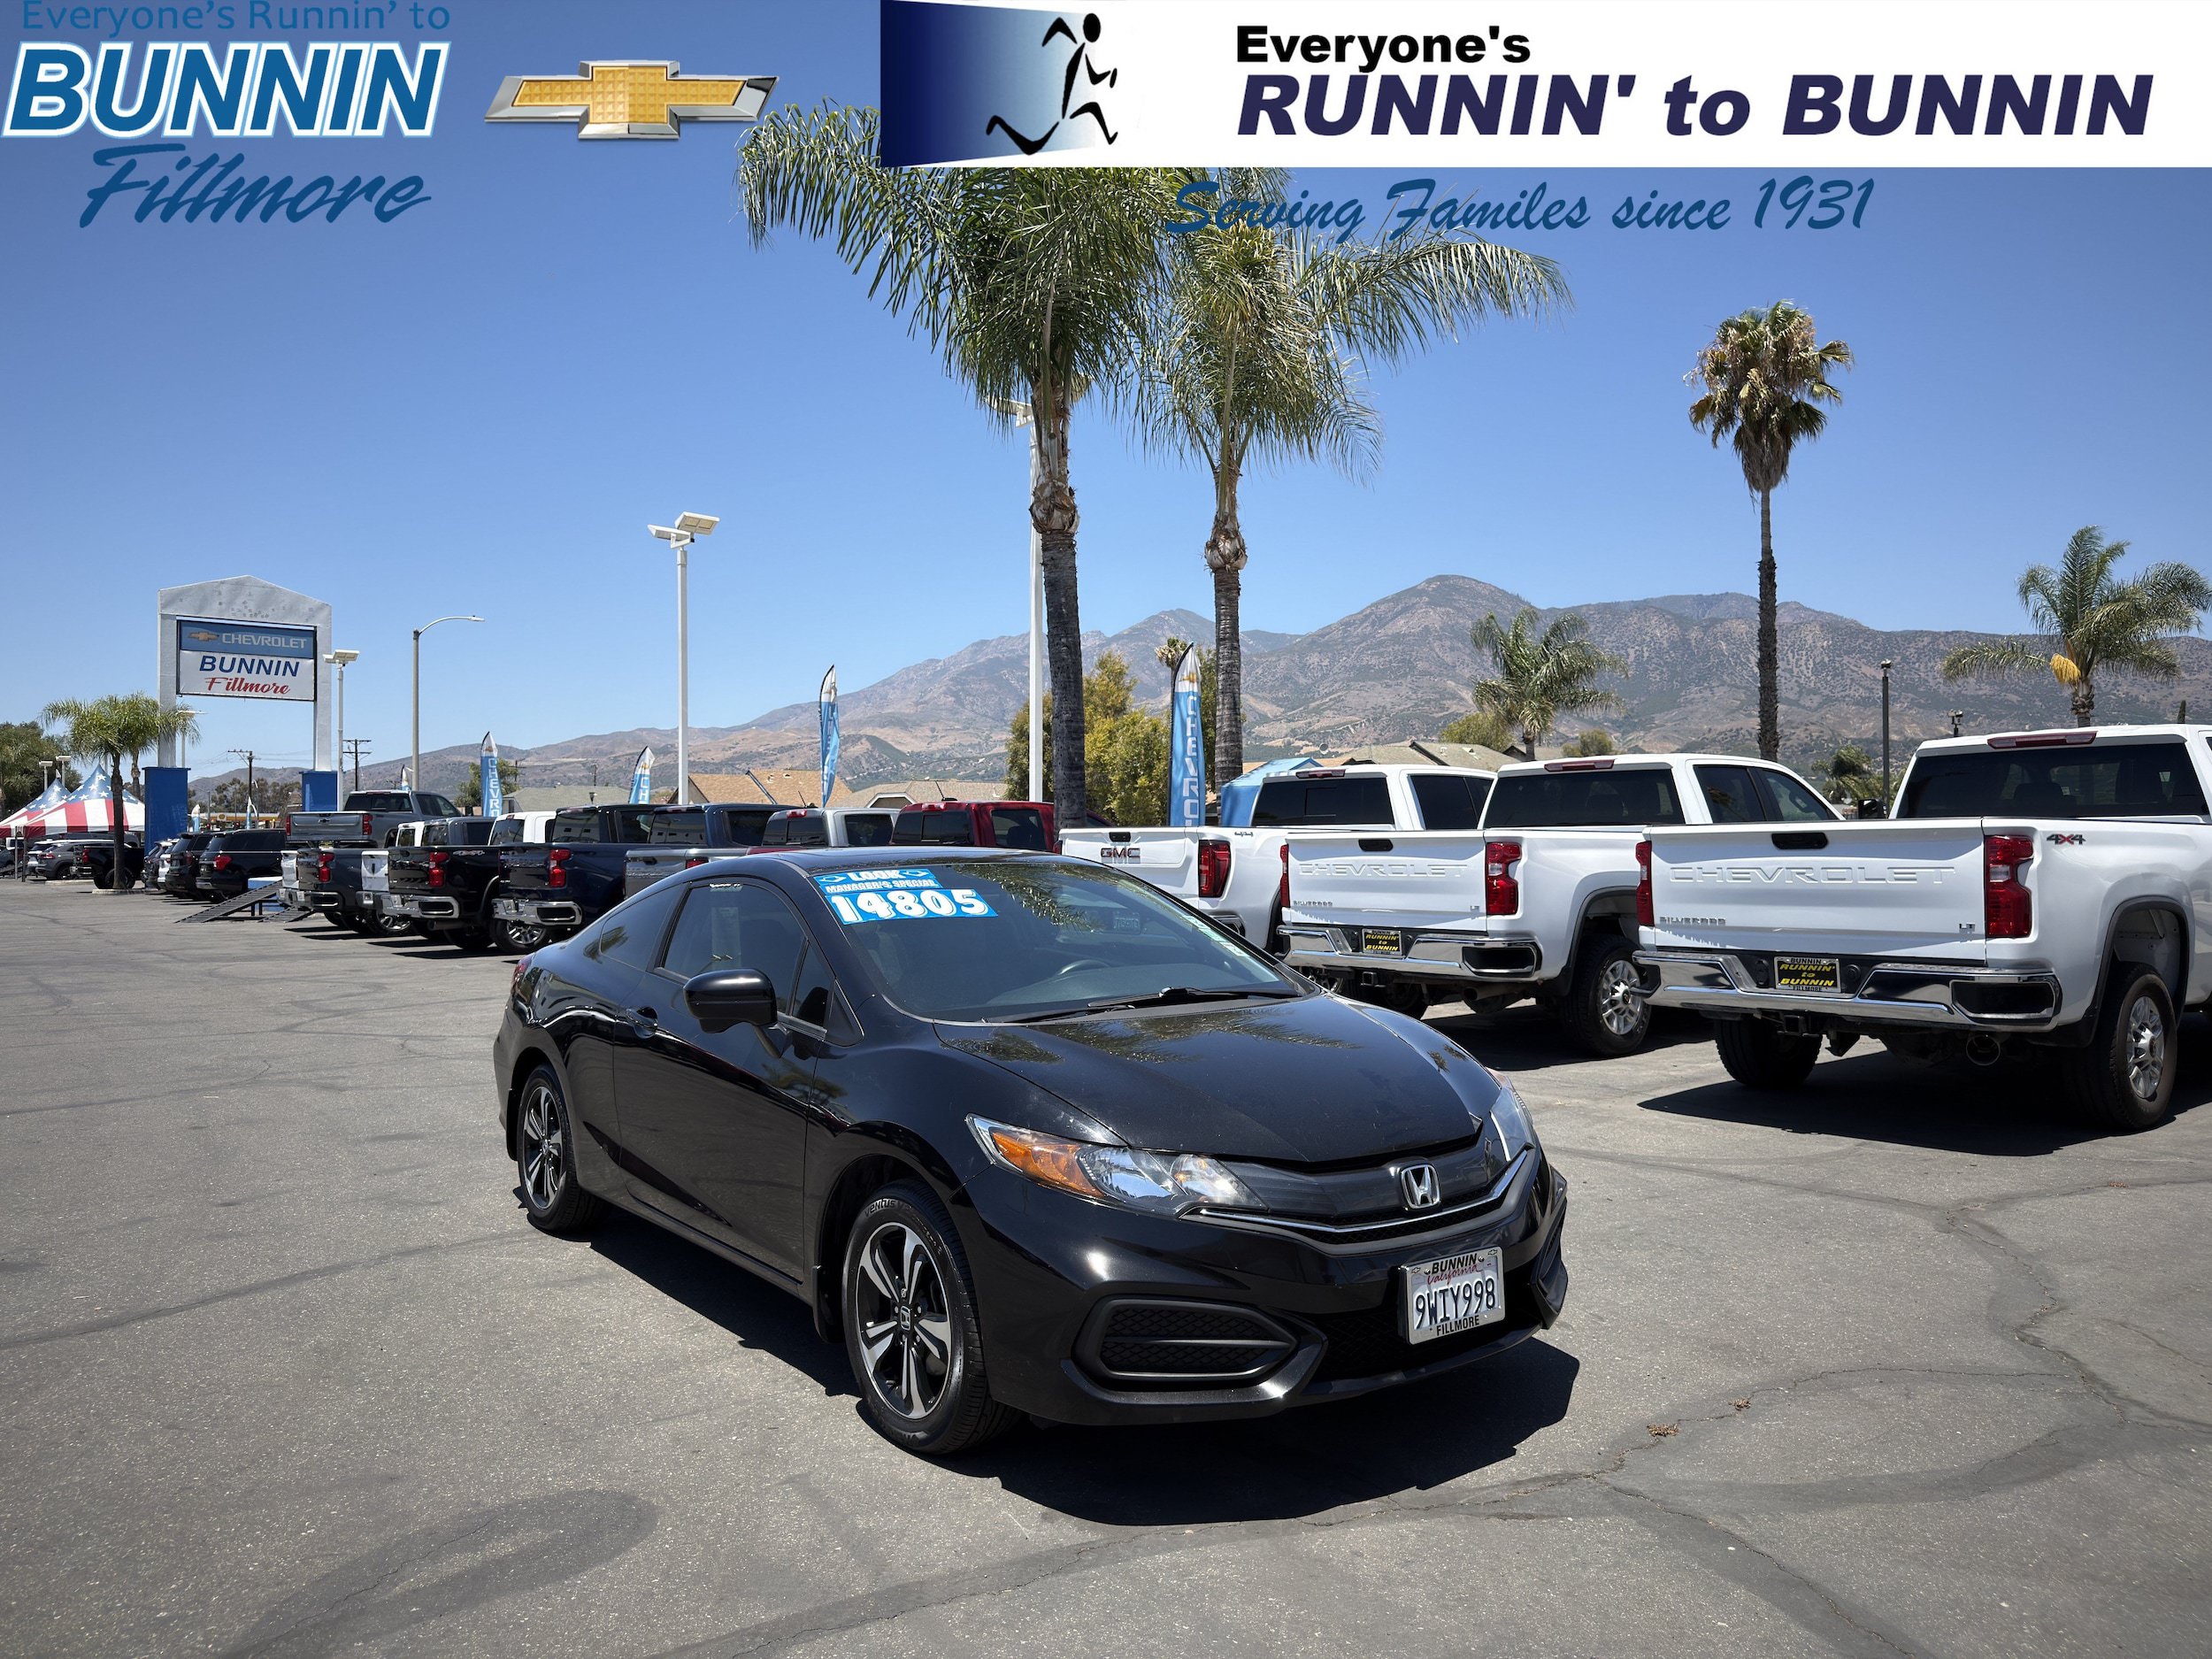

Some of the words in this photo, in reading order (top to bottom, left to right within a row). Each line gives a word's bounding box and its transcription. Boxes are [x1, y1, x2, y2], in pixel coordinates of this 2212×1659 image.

[222, 633, 308, 649] CHEVROLET
[199, 655, 300, 678] BUNNIN
[204, 677, 291, 695] Fillmore
[1101, 848, 1141, 858] GMC
[847, 869, 906, 881] LOOK
[1299, 864, 1468, 878] CHEVROLET
[1670, 866, 1955, 884] CHEVROLET
[826, 880, 893, 894] MANAGER'S
[892, 879, 940, 888] SPECIAL
[831, 888, 989, 923] 14805
[1779, 964, 1835, 972] RUNNIN'
[1780, 978, 1834, 987] BUNNIN
[1432, 1253, 1478, 1275] BUNNIN
[1415, 1277, 1495, 1330] 9WIY998
[1436, 1315, 1479, 1336] FILLMORE
